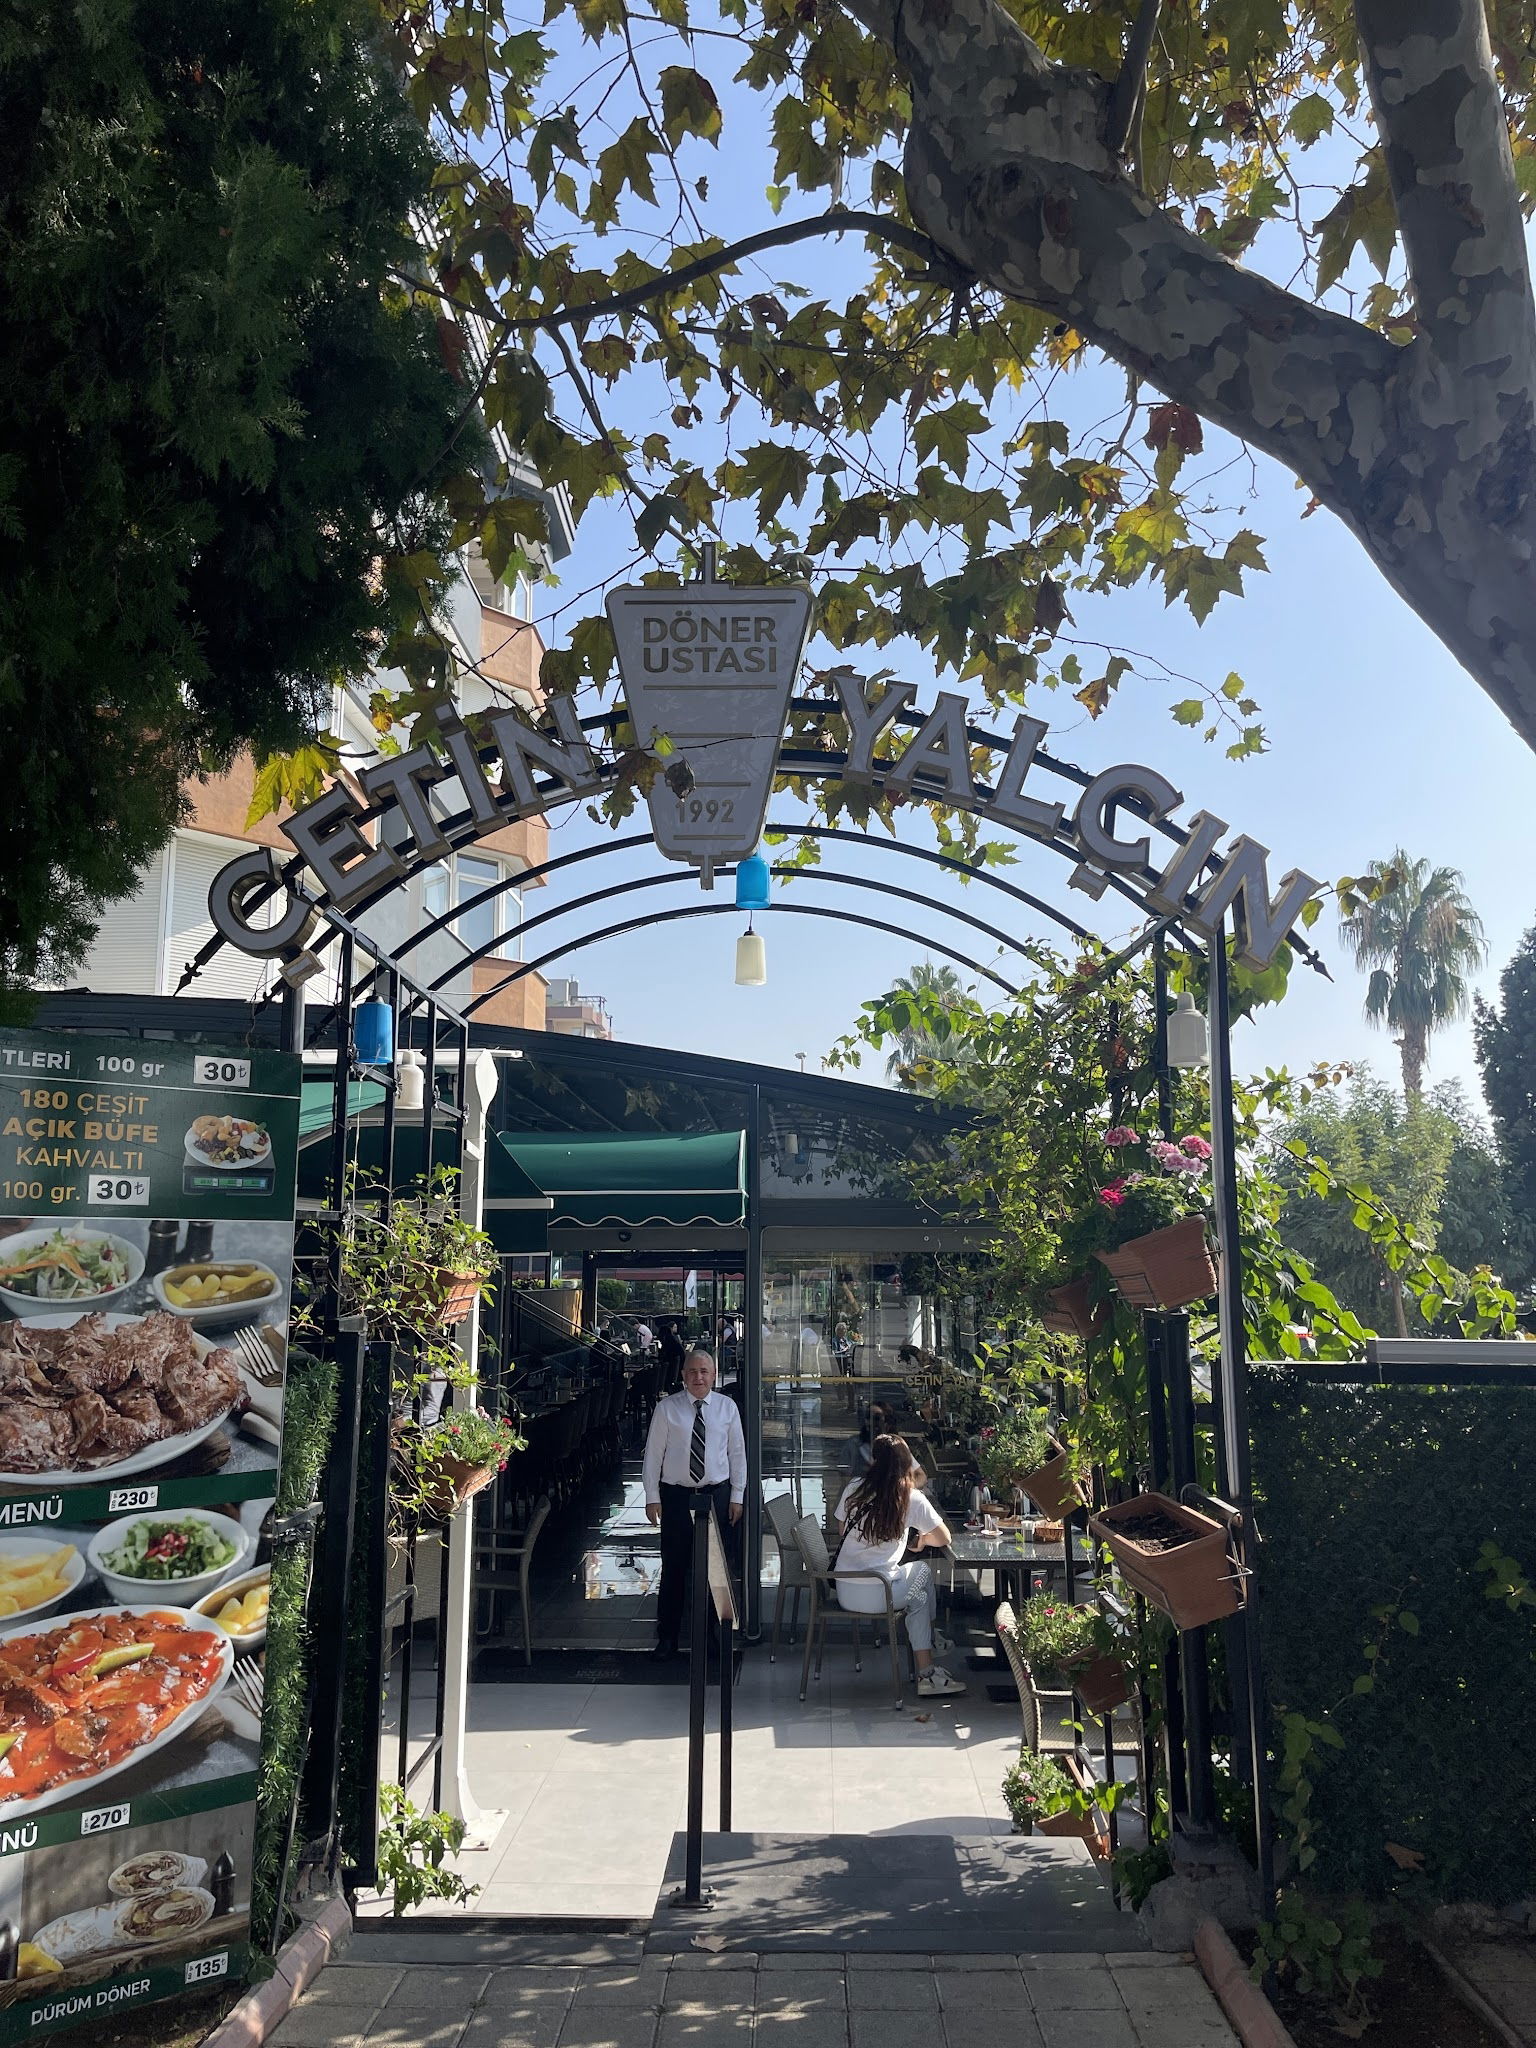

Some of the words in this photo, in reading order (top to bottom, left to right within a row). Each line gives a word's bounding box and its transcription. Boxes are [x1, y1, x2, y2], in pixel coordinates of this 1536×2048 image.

[643, 610, 777, 643] DÖNER
[643, 646, 777, 673] USTASI
[675, 800, 734, 823] 1992
[207, 693, 601, 990] ÇETİN
[833, 673, 1326, 974] YALÇIN
[96, 1055, 135, 1073] 100
[141, 1062, 165, 1077] gr
[20, 1088, 68, 1110] 180
[77, 1092, 149, 1118] ÇEŞİT
[3, 1117, 77, 1141] AÇIK
[84, 1116, 159, 1143] BÜFE
[15, 1147, 143, 1170] KAHVALTI
[2, 1181, 43, 1199] 100
[51, 1185, 80, 1204] gr.
[0, 1821, 38, 1852] NÜ
[31, 1996, 92, 2026] DÜRÜM
[96, 1979, 151, 2007] DÖNER
